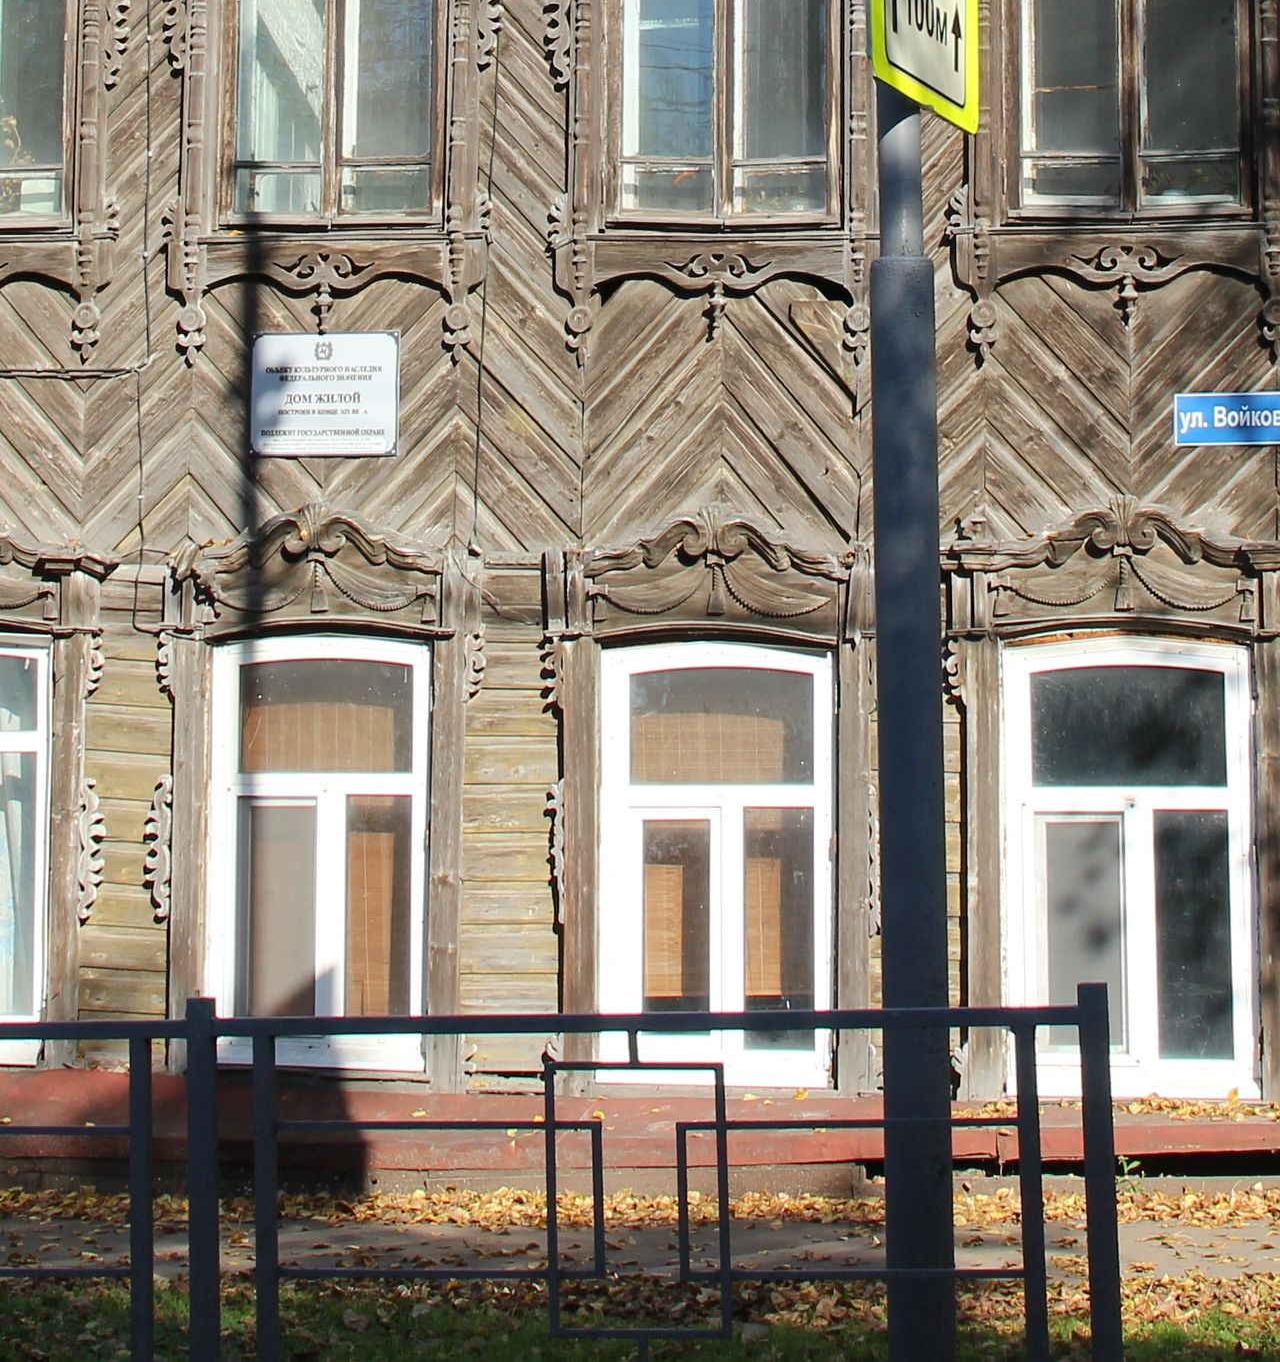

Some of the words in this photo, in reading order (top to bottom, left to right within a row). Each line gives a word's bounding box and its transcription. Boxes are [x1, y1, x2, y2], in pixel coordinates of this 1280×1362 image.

[293, 365, 343, 373] КУЛЬТУРНОГО
[344, 365, 382, 373] НАСЛЕДИЯ
[278, 374, 335, 382] ФЕДЕРАЛЬНОГО
[285, 394, 312, 405] ДОМ
[315, 392, 361, 404] ЖИЛОЙ
[1179, 410, 1208, 434] ул.
[261, 429, 295, 437] ПОДЛЕЖИТ
[297, 428, 359, 436] ГОСУДАРСТВЕННОЙ
[360, 428, 385, 436] ОХРАНЕ
